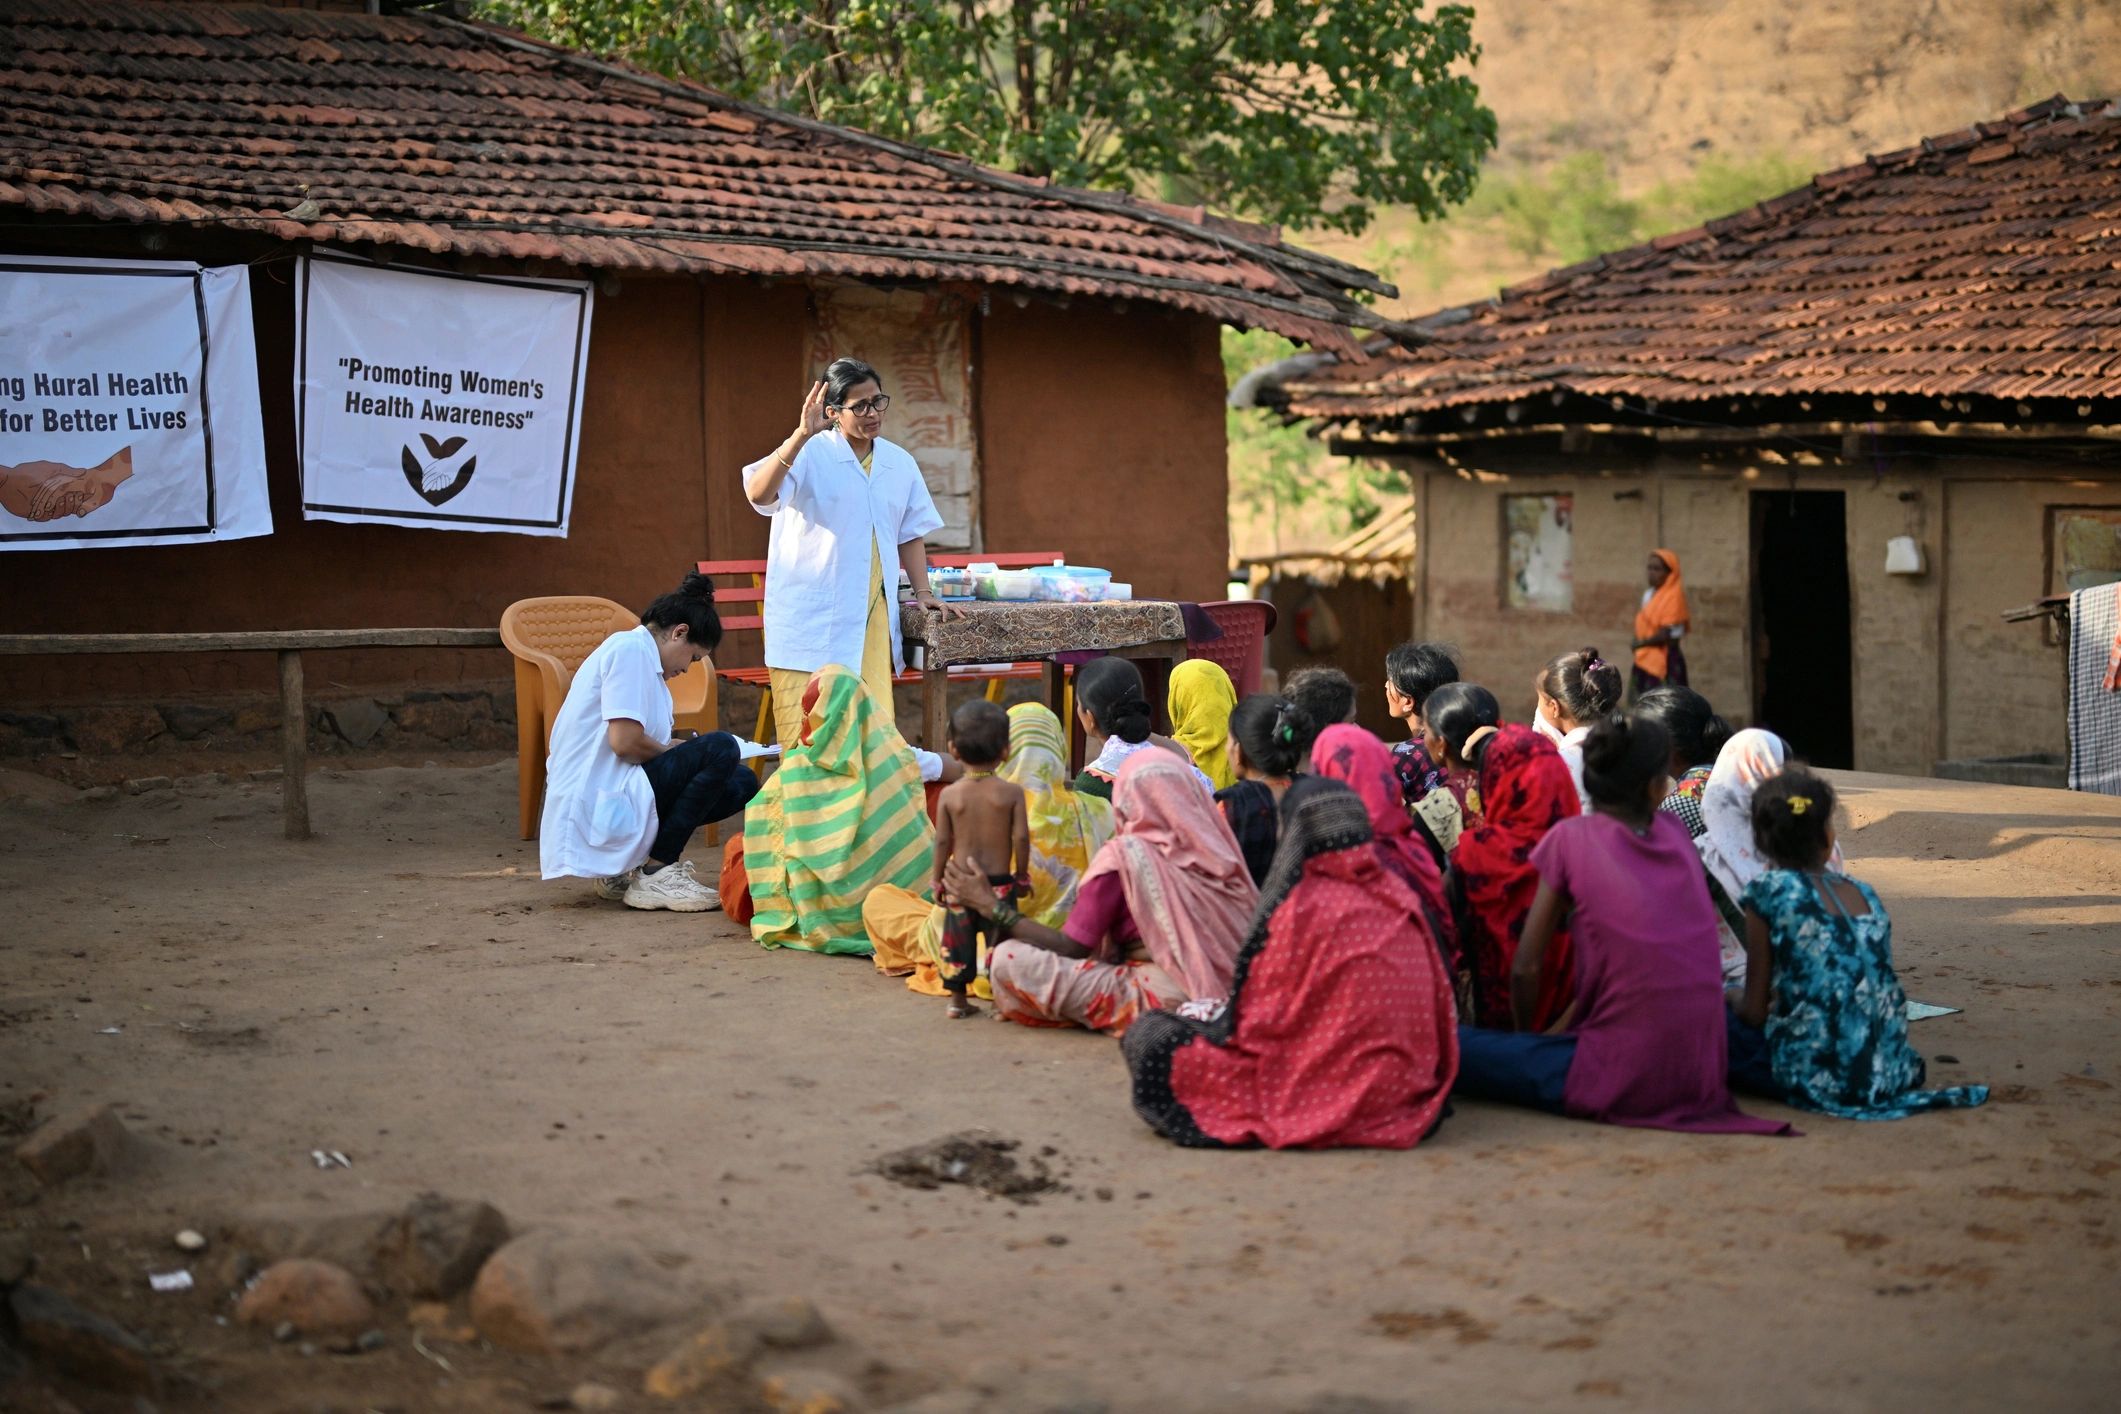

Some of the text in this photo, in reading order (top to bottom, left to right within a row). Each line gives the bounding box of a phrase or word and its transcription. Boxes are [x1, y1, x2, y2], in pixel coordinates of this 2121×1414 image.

[107, 371, 189, 397] Health
[338, 358, 544, 400] "Promoting Women's
[42, 408, 118, 433] Better
[126, 406, 187, 431] Lives
[345, 390, 534, 430] Health Awareness"
